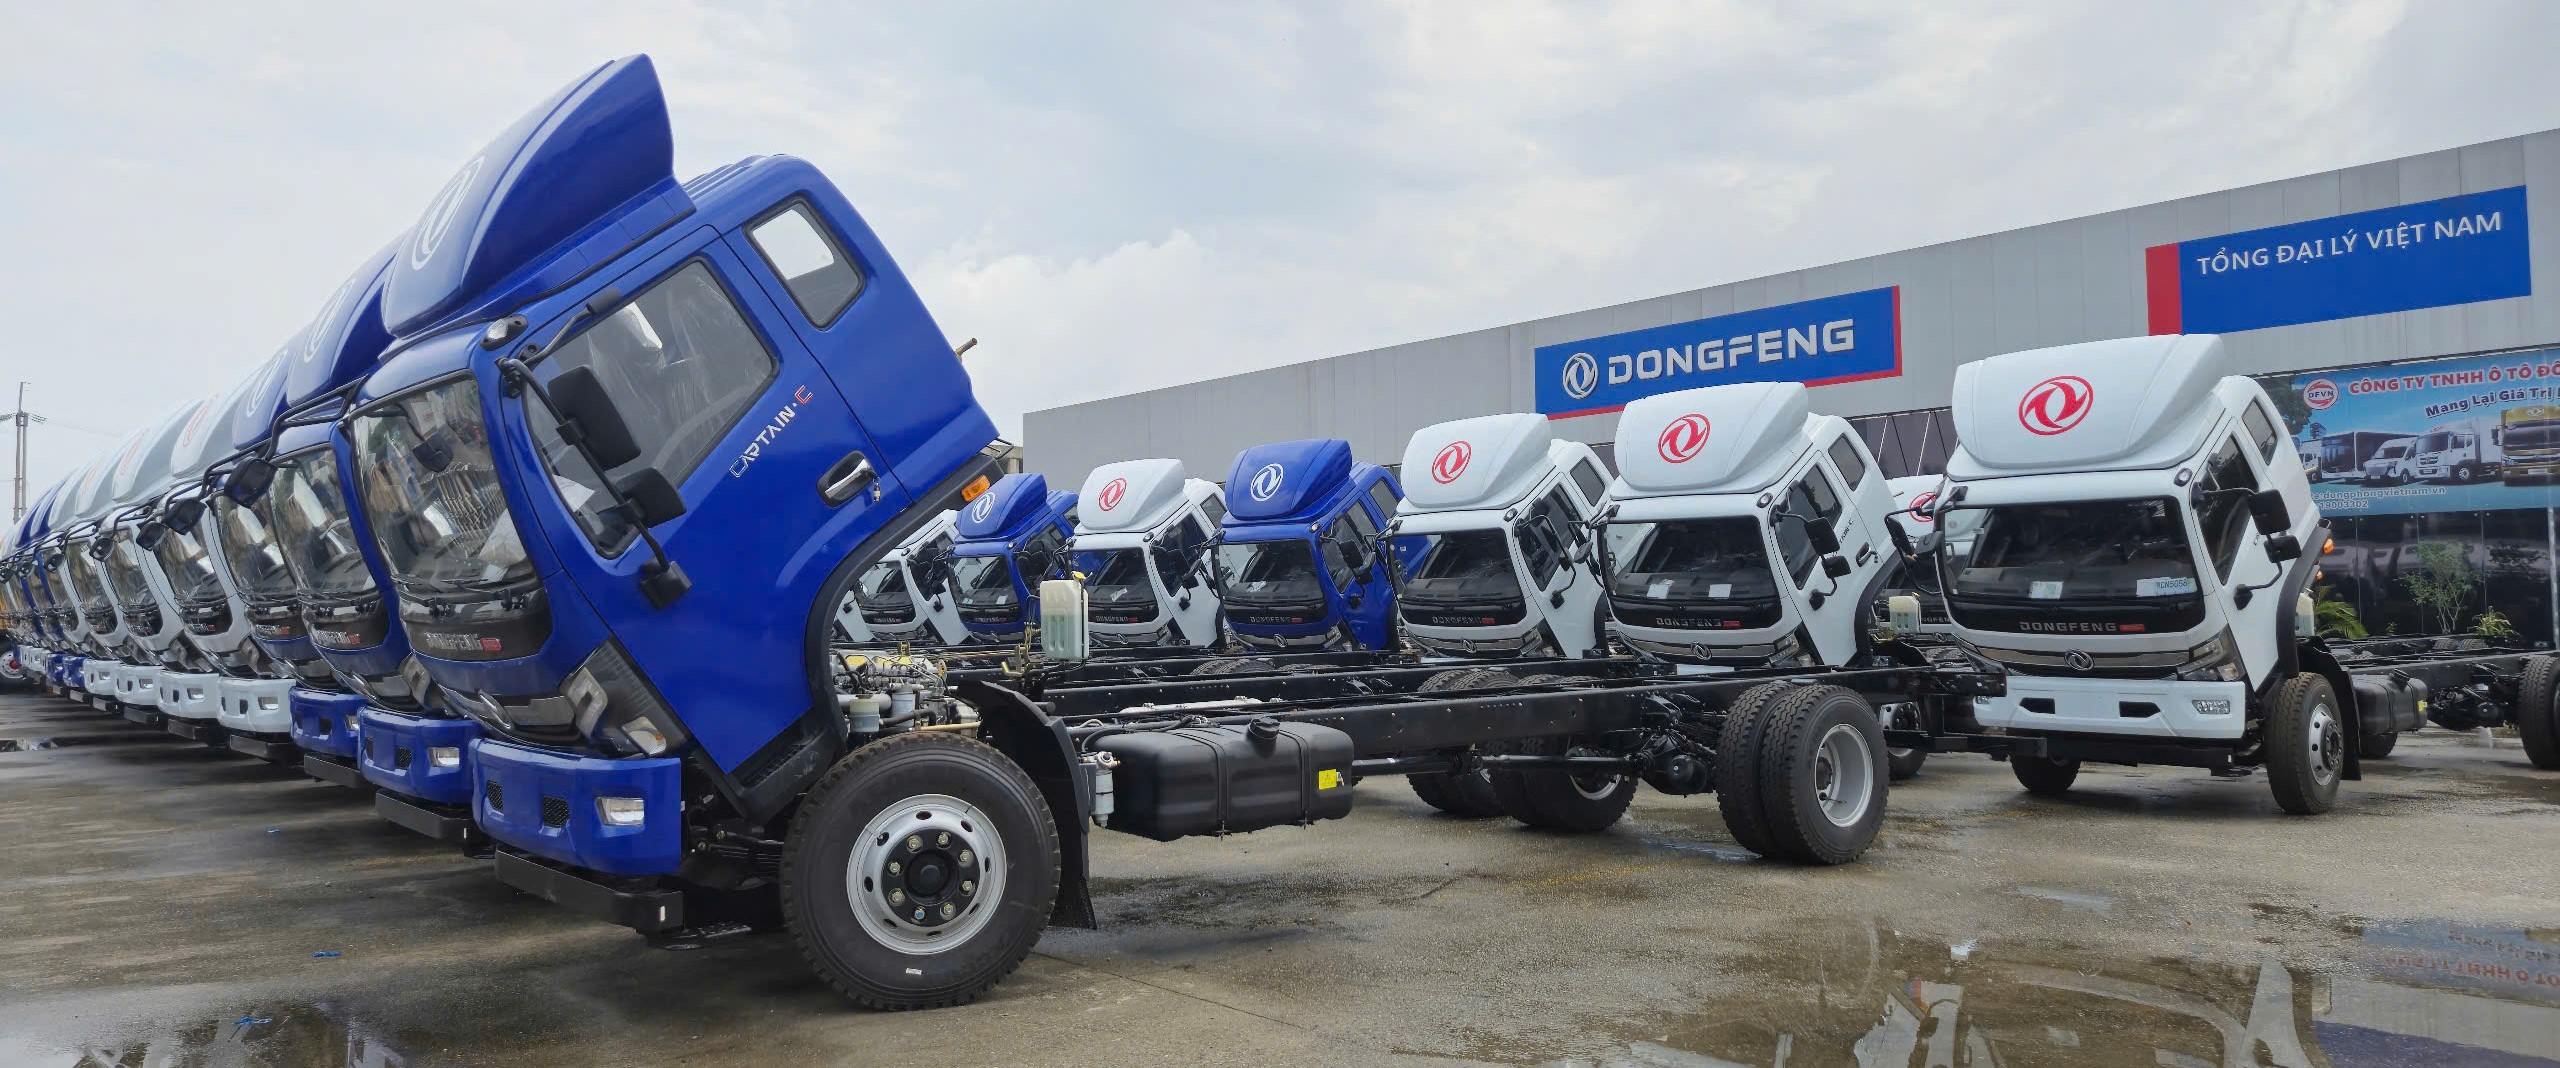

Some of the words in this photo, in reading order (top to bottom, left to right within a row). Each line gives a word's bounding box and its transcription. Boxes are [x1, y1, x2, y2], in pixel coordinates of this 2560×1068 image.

[2197, 247, 2268, 275] TỔNG
[2277, 240, 2323, 264] ĐẠI
[2331, 229, 2357, 255] LÝ
[2366, 222, 2426, 249] VIỆT
[2434, 211, 2501, 240] NAM
[1608, 318, 1855, 386] DONGFENG
[2308, 390, 2334, 399] DFVN
[2350, 377, 2399, 394] CÔNG
[2403, 376, 2425, 389] TY
[2430, 371, 2483, 387] TNHH
[2489, 366, 2501, 381] Ô
[2506, 364, 2532, 379] TÔ
[2425, 399, 2469, 418] Mang
[2472, 392, 2496, 407] Lại
[2499, 388, 2526, 401] Giá
[2529, 386, 2553, 401] Trị
[2019, 621, 2117, 632] DONGFENG
